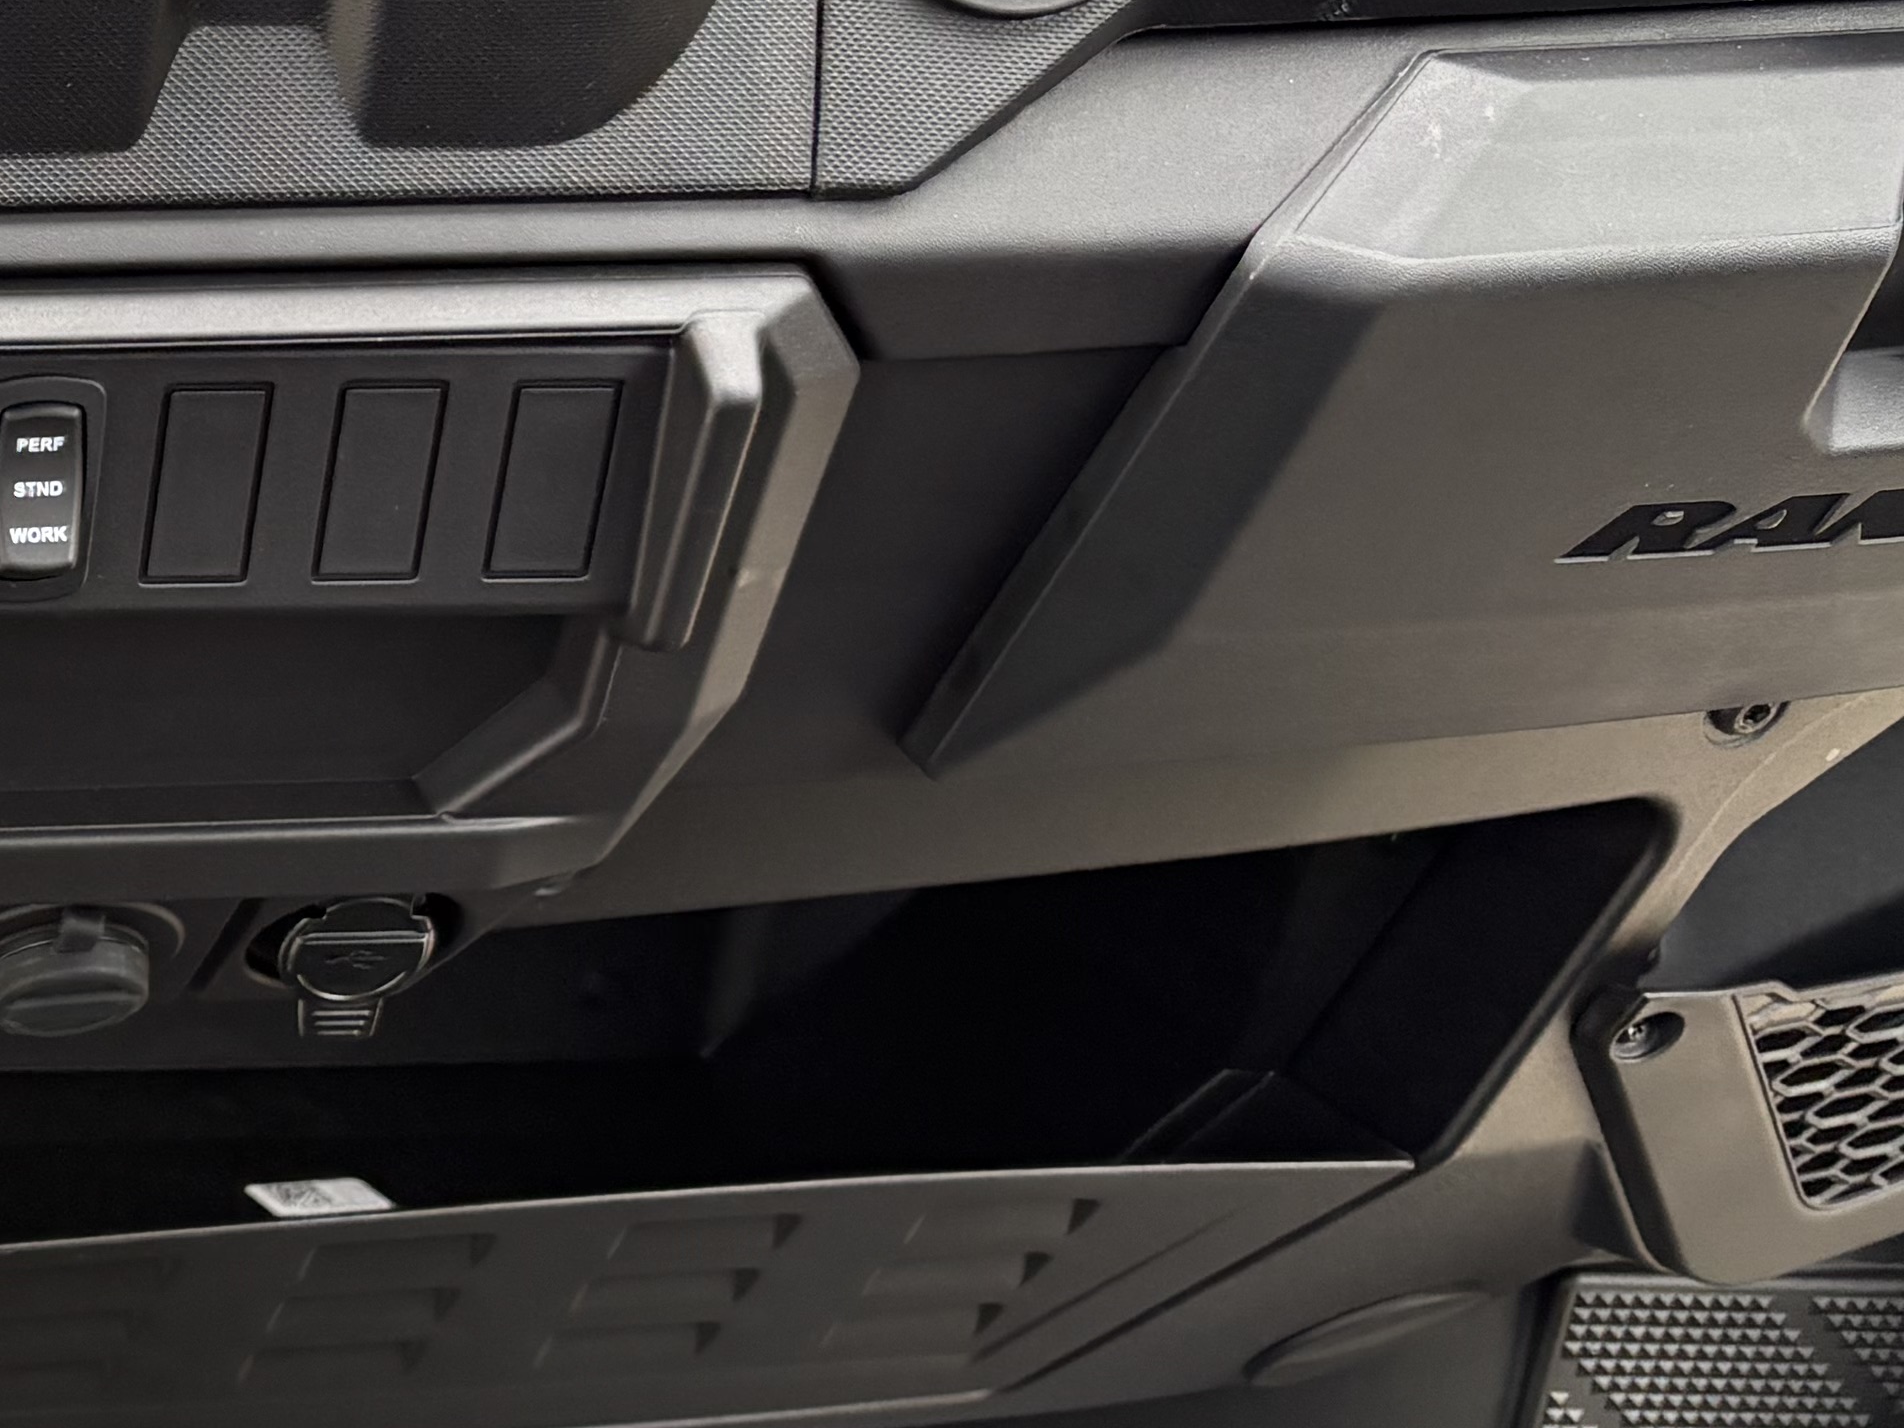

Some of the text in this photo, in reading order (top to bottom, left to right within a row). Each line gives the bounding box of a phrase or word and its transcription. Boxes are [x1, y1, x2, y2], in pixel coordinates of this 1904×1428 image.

[16, 435, 65, 453] PERF
[13, 480, 64, 498] STND
[9, 525, 68, 544] WORK
